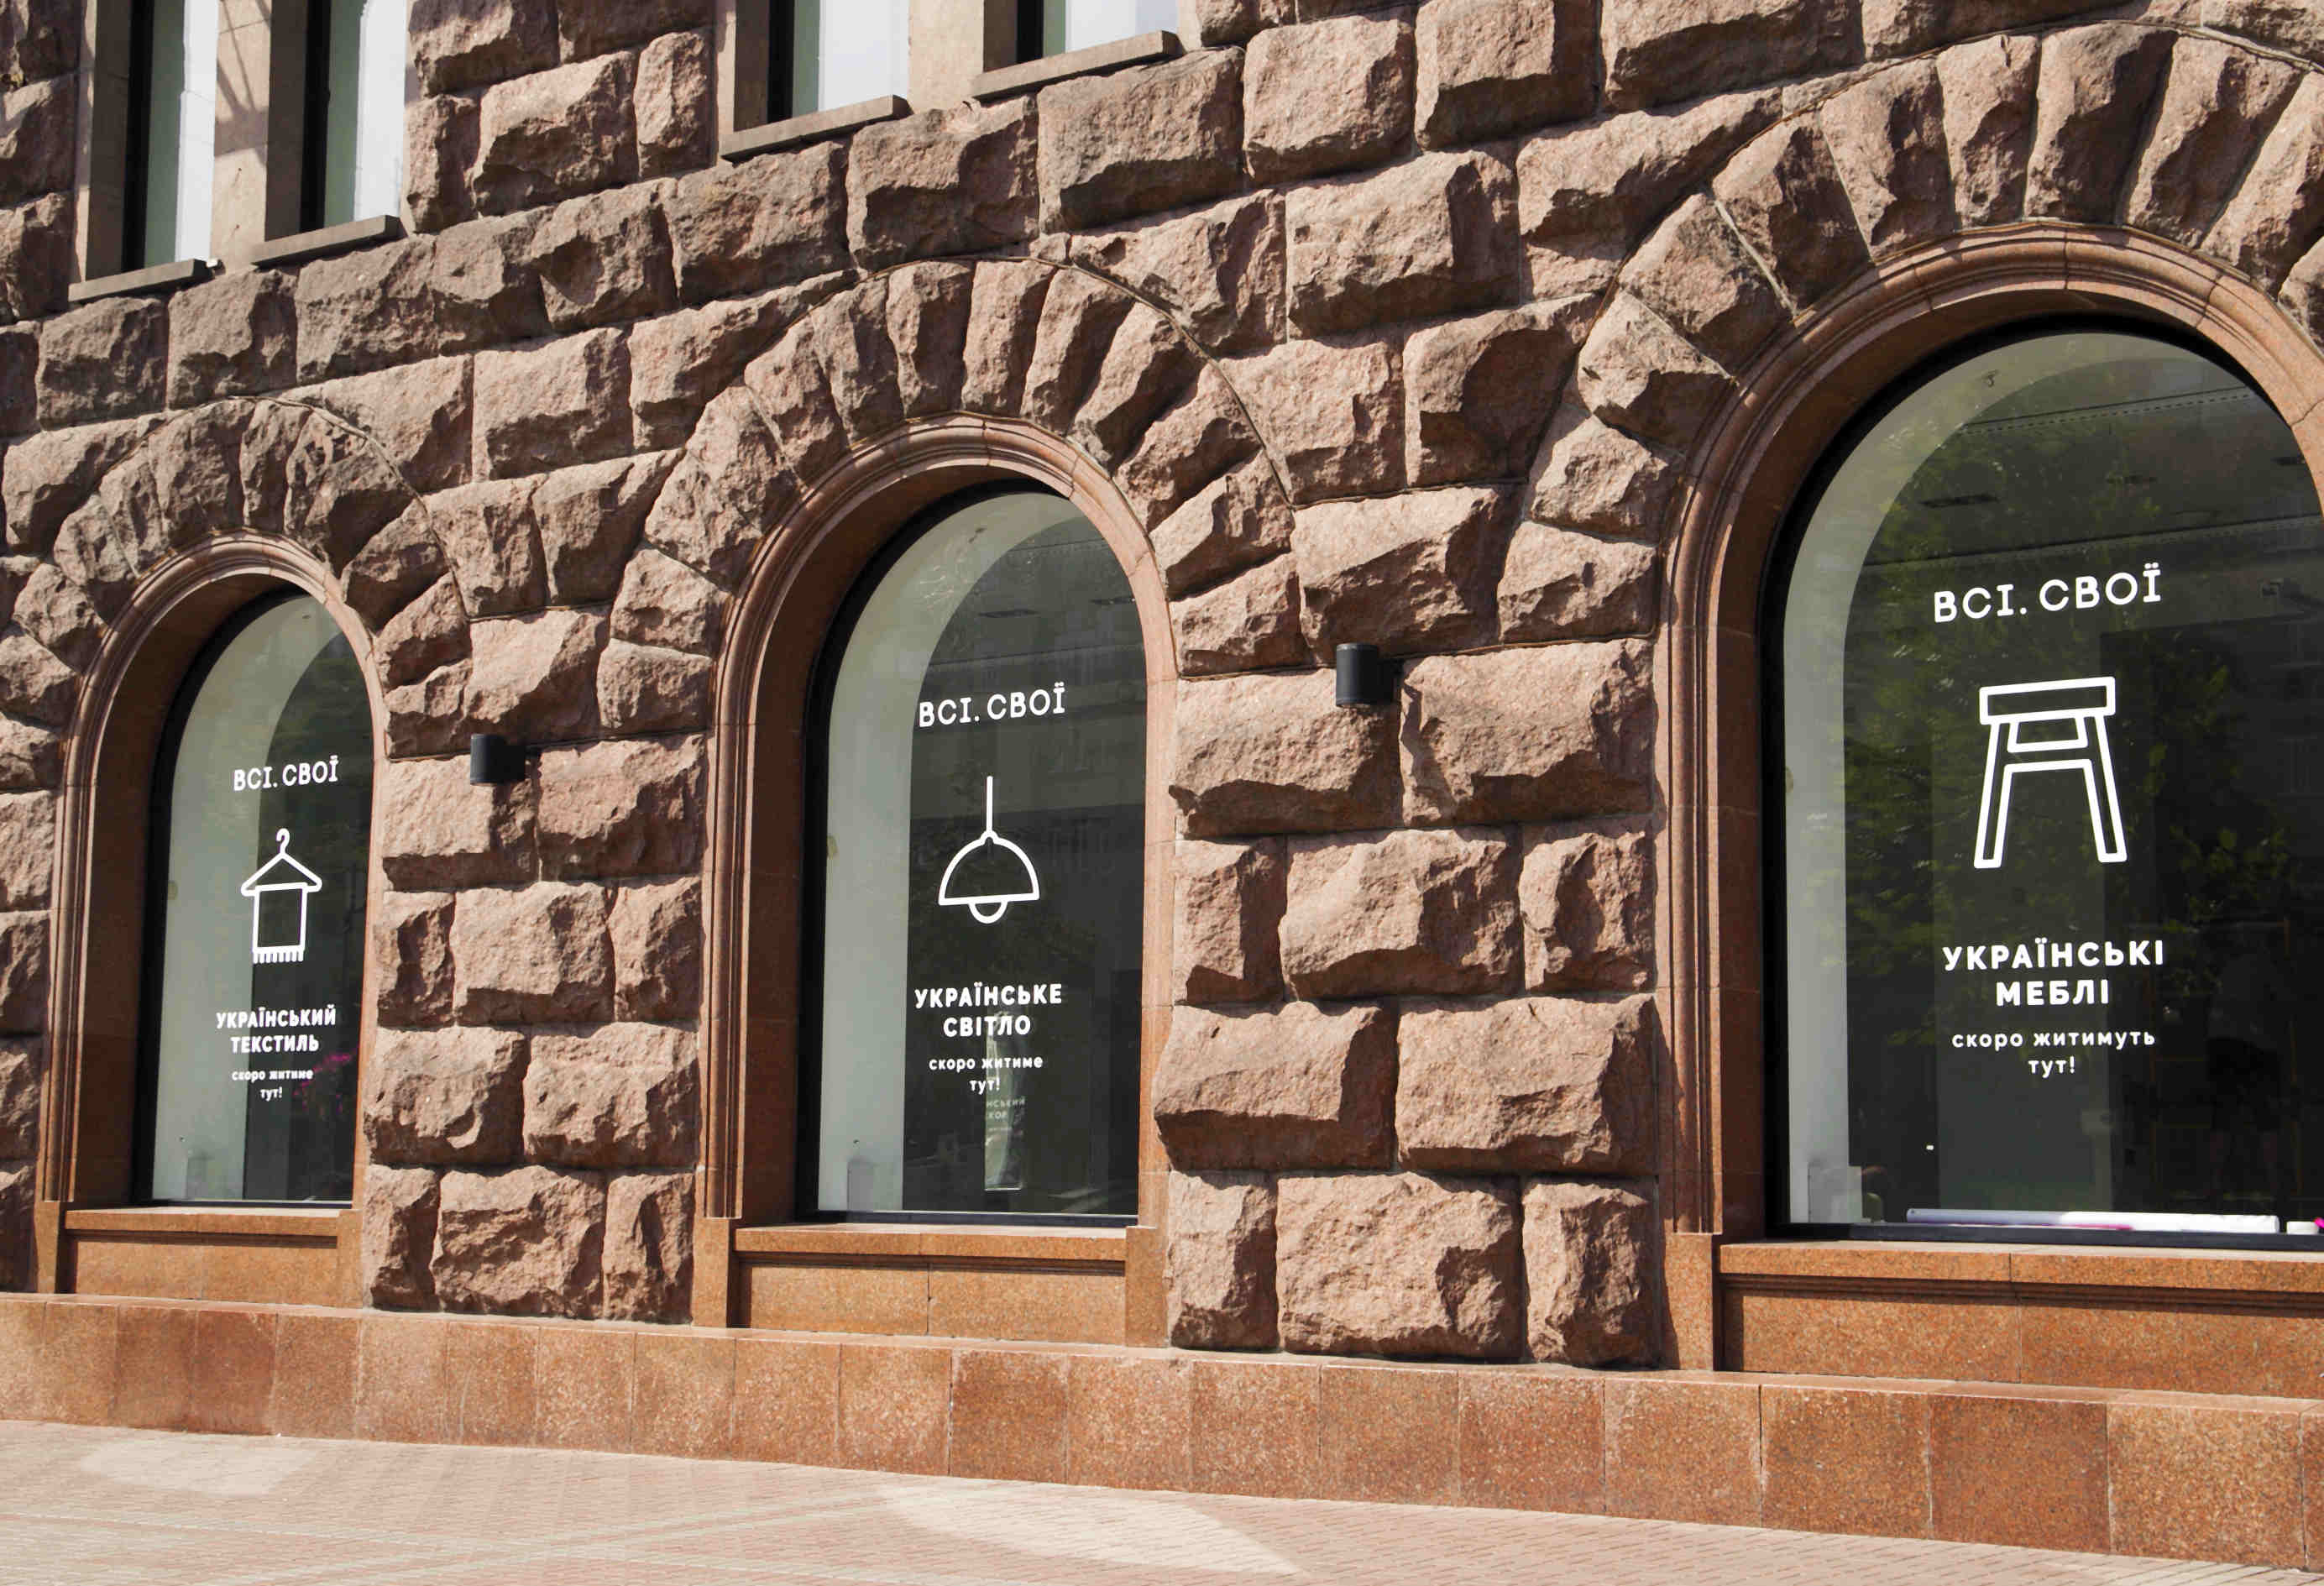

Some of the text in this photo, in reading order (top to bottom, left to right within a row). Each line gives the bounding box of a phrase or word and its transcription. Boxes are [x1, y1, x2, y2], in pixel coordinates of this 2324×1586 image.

[1934, 562, 2162, 623] ВСІ. СВОЇ
[919, 681, 1065, 727] ВСІ. СВОЇ
[233, 755, 339, 792] ВСІ. СВОЇ
[1942, 937, 2164, 971] УКРАЇНСЬКІ
[914, 981, 1062, 1009] УКРАЇНСЬКЕ
[1996, 979, 2109, 1007] МЕБЛІ
[216, 1004, 337, 1029] УКРАЇНСЬКИЙ
[943, 1015, 1031, 1038] СВІТЛО
[230, 1034, 319, 1054] ТЕКСТИЛЬ
[1951, 1031, 2155, 1051] скоро житимуть
[232, 1070, 266, 1083] скоро
[929, 1056, 1044, 1073] скоро житиме
[2028, 1055, 2075, 1079] тут!
[260, 1086, 283, 1102] тут!
[969, 1076, 1001, 1095] тут!
